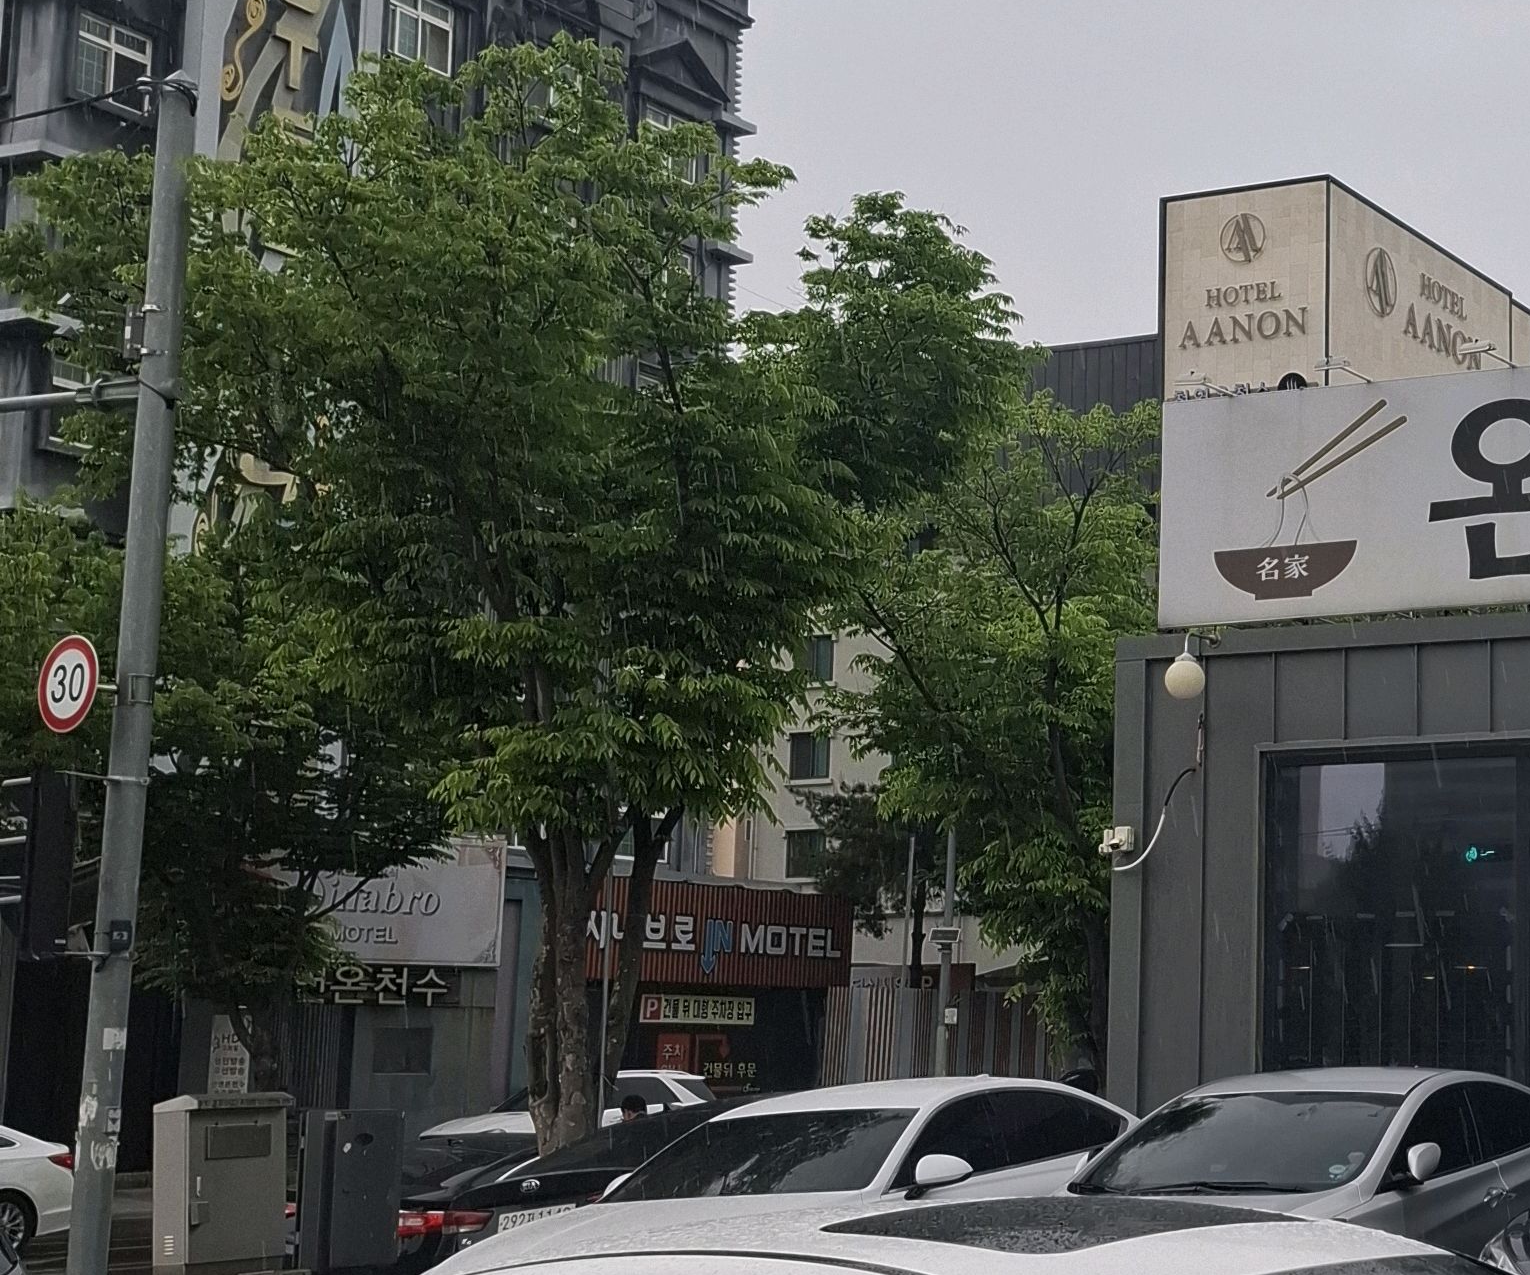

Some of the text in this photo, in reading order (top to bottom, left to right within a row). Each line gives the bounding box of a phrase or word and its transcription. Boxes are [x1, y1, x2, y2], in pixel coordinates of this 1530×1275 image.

[1205, 281, 1282, 308] HOTEL
[1419, 273, 1468, 321] HOTEL
[1179, 307, 1308, 349] AANON
[1256, 554, 1310, 582] 名家
[50, 662, 86, 705] 30
[740, 923, 842, 958] MOTEL
[645, 998, 659, 1018] P
[711, 999, 734, 1020] 주차장
